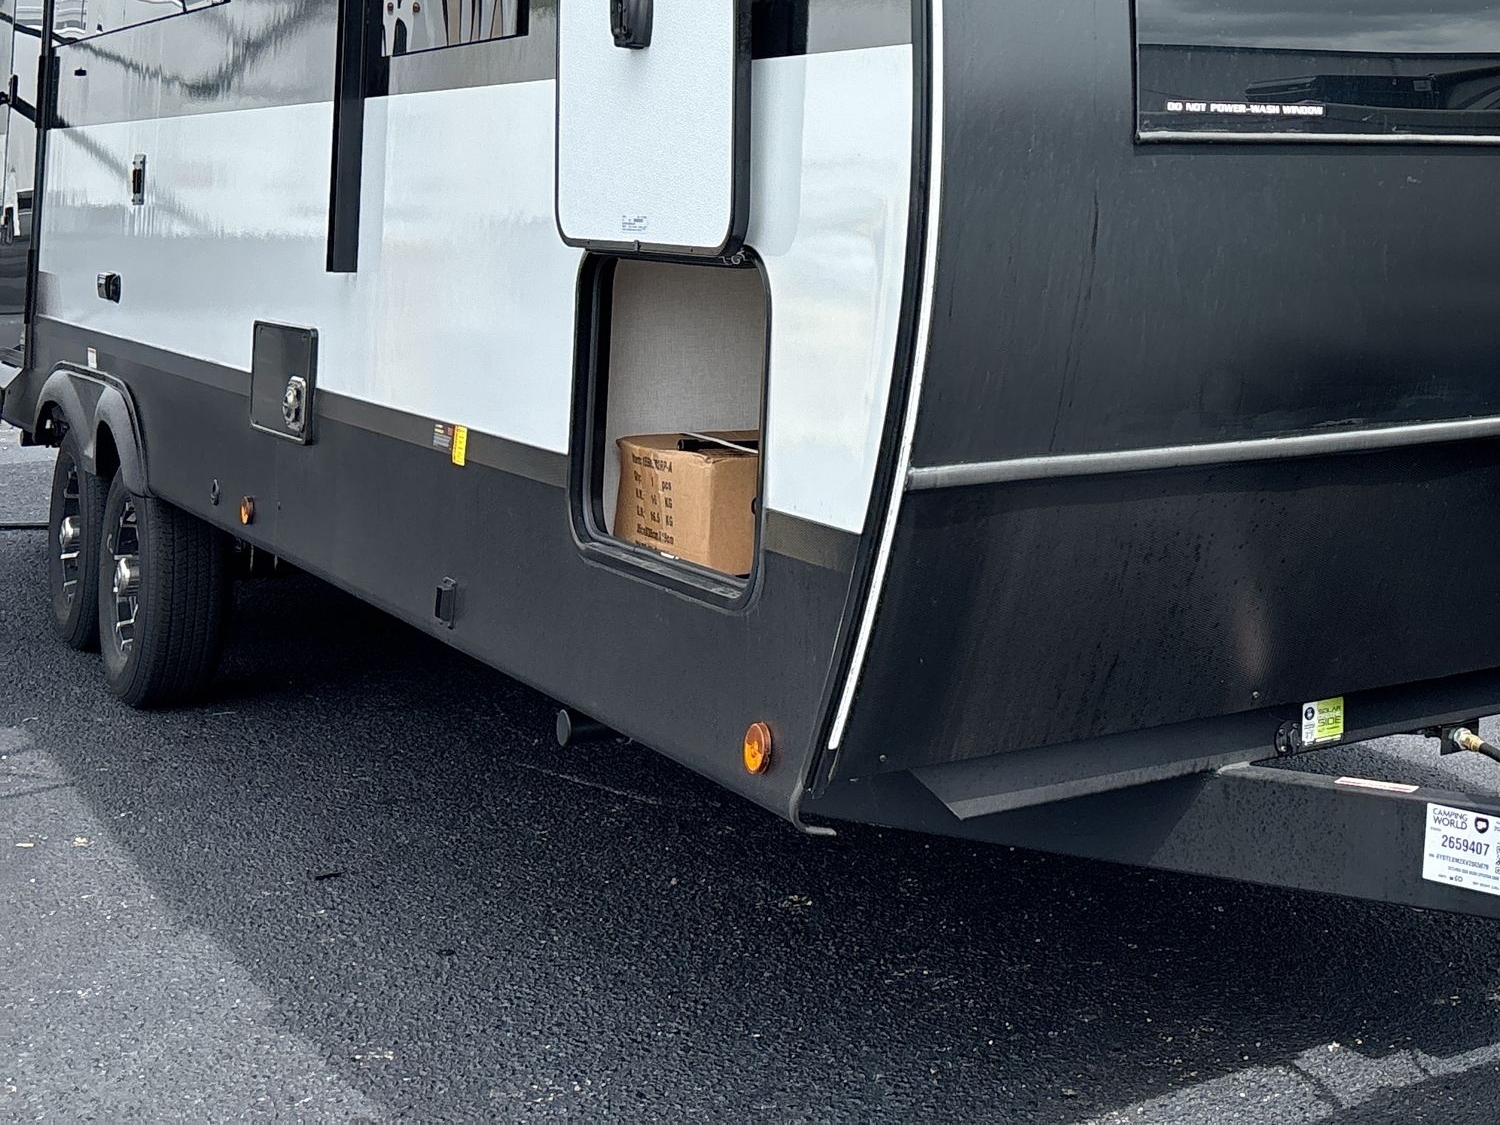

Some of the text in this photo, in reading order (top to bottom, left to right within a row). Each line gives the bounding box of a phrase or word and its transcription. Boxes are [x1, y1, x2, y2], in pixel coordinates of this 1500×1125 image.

[1167, 101, 1323, 116] DO NOT POWER-WASH WINDOW
[1318, 705, 1341, 714] SOLAR
[1318, 716, 1341, 727] SIDE
[1432, 807, 1468, 822] CAMPING
[1433, 815, 1468, 830] WORLD
[1441, 834, 1490, 856] 2659407
